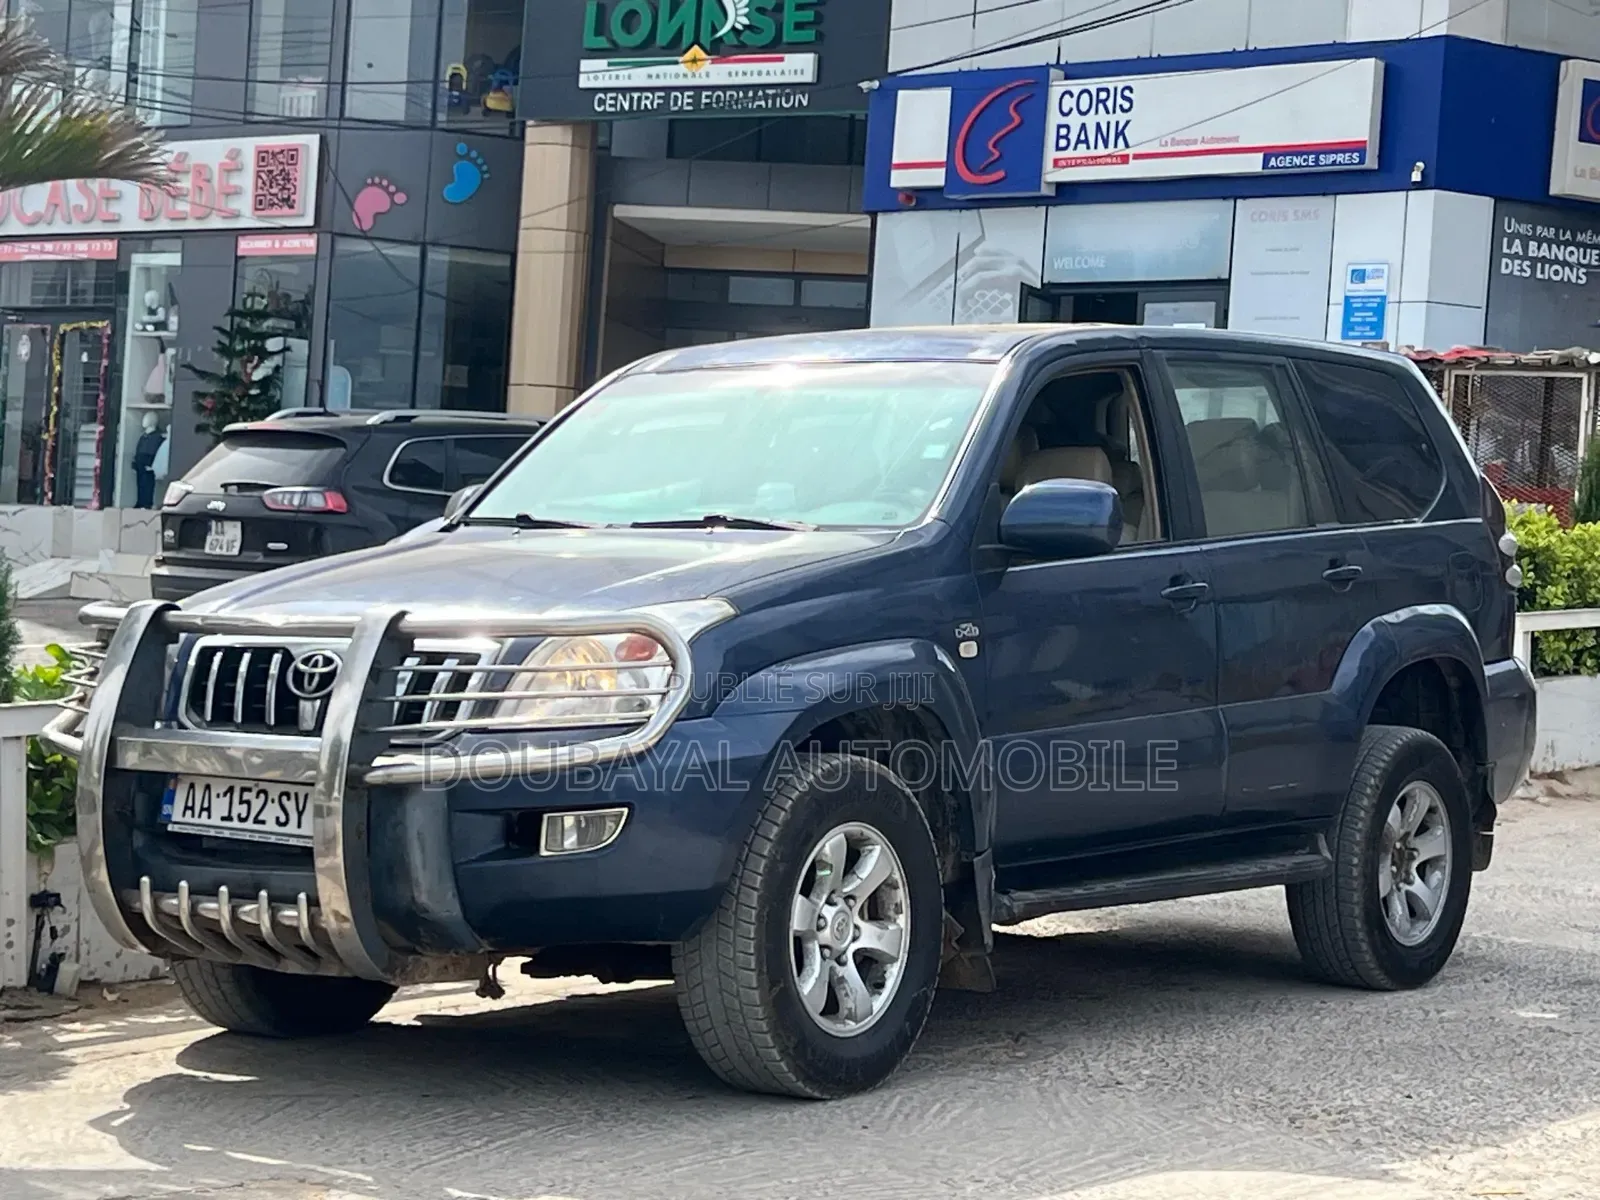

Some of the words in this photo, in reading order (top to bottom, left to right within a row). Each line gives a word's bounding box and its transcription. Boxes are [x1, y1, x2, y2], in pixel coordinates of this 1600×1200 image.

[670, 91, 694, 111] DE
[700, 88, 809, 109] FORMATION
[1058, 85, 1134, 117] CORIS
[1055, 120, 1132, 152] BANK
[1268, 154, 1316, 168] AGENCE
[1319, 152, 1360, 166] SIPRES
[1536, 225, 1555, 239] PAR
[1559, 228, 1572, 242] LA
[1052, 255, 1106, 270] WELCOME
[1502, 236, 1523, 256] LA
[1528, 240, 1600, 266] BANQUE
[1501, 258, 1531, 278] DES
[1536, 262, 1587, 285] LIONS
